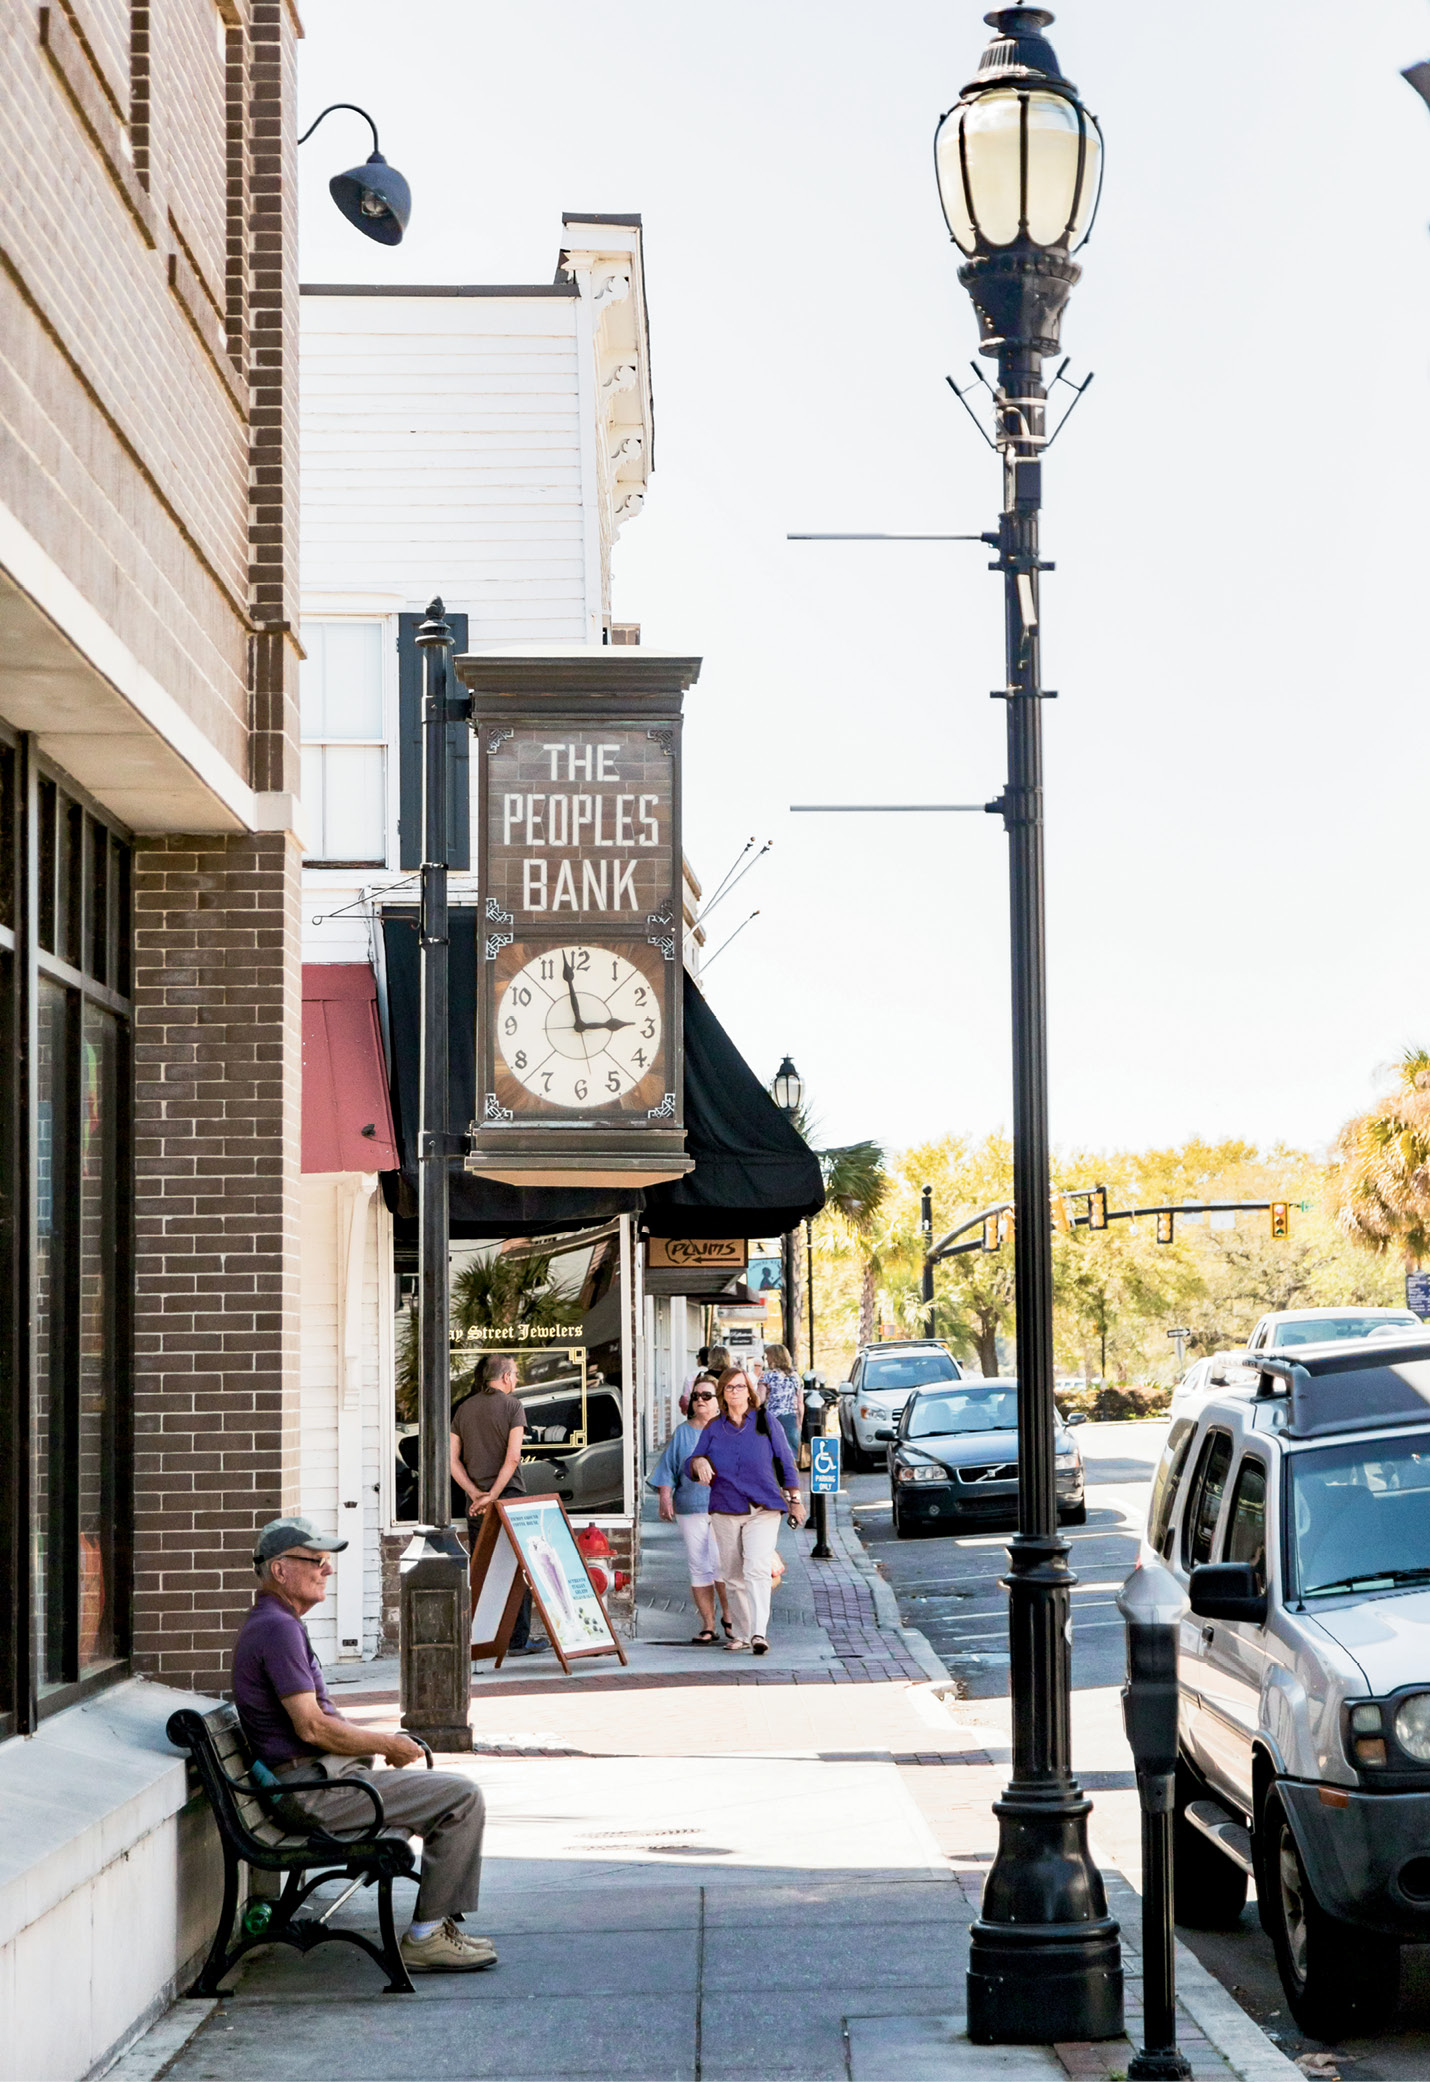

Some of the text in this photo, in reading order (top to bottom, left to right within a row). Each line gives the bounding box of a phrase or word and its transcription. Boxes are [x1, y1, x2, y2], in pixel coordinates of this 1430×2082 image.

[543, 744, 620, 782] THE
[503, 793, 659, 847] PEOPLES
[522, 859, 639, 911] BANK
[541, 959, 554, 980] 11
[570, 951, 591, 971] 12
[611, 960, 620, 982] 1
[511, 986, 532, 1007] 10
[634, 987, 648, 1007] 2
[505, 1016, 518, 1036] 9
[640, 1016, 656, 1039] 3
[515, 1049, 527, 1070] 8
[631, 1048, 647, 1068] 4
[541, 1072, 554, 1092] 7
[574, 1079, 588, 1100] 6
[605, 1071, 621, 1092] 5
[449, 1323, 583, 1343] ay Street Jewelers
[815, 1474, 836, 1483] PARKING
[819, 1482, 832, 1491] ONLY
